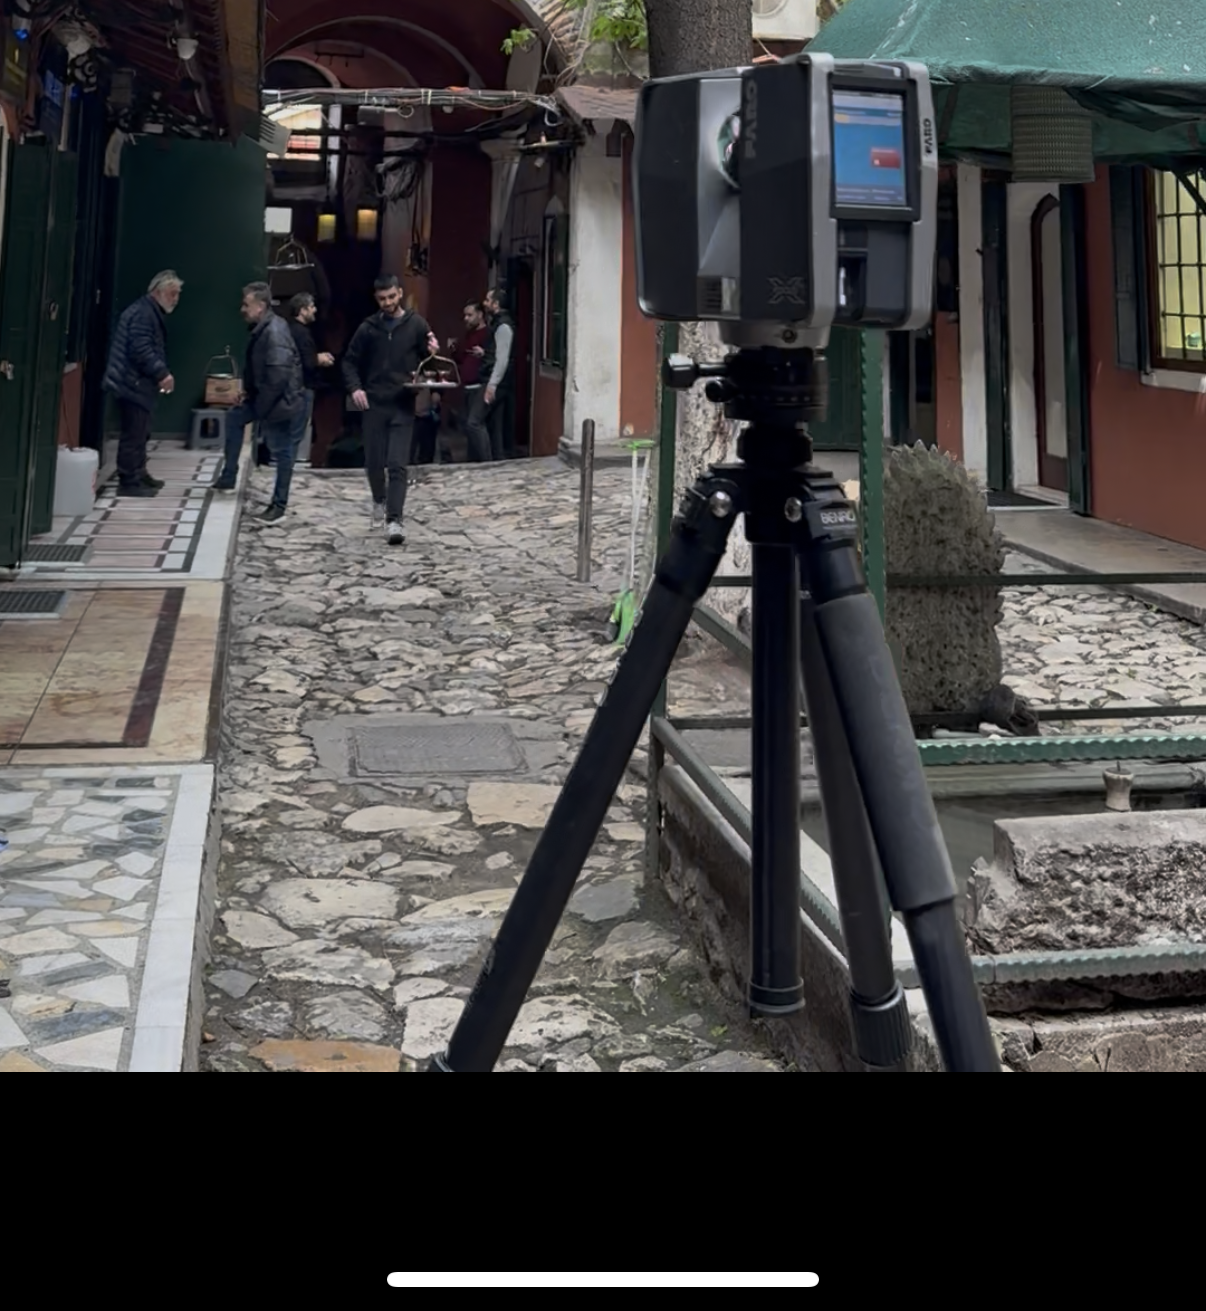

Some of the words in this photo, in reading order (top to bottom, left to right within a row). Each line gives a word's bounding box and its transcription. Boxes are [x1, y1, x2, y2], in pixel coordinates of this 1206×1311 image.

[745, 79, 757, 159] FARO
[923, 118, 933, 155] FARO
[820, 511, 857, 524] BENRO
